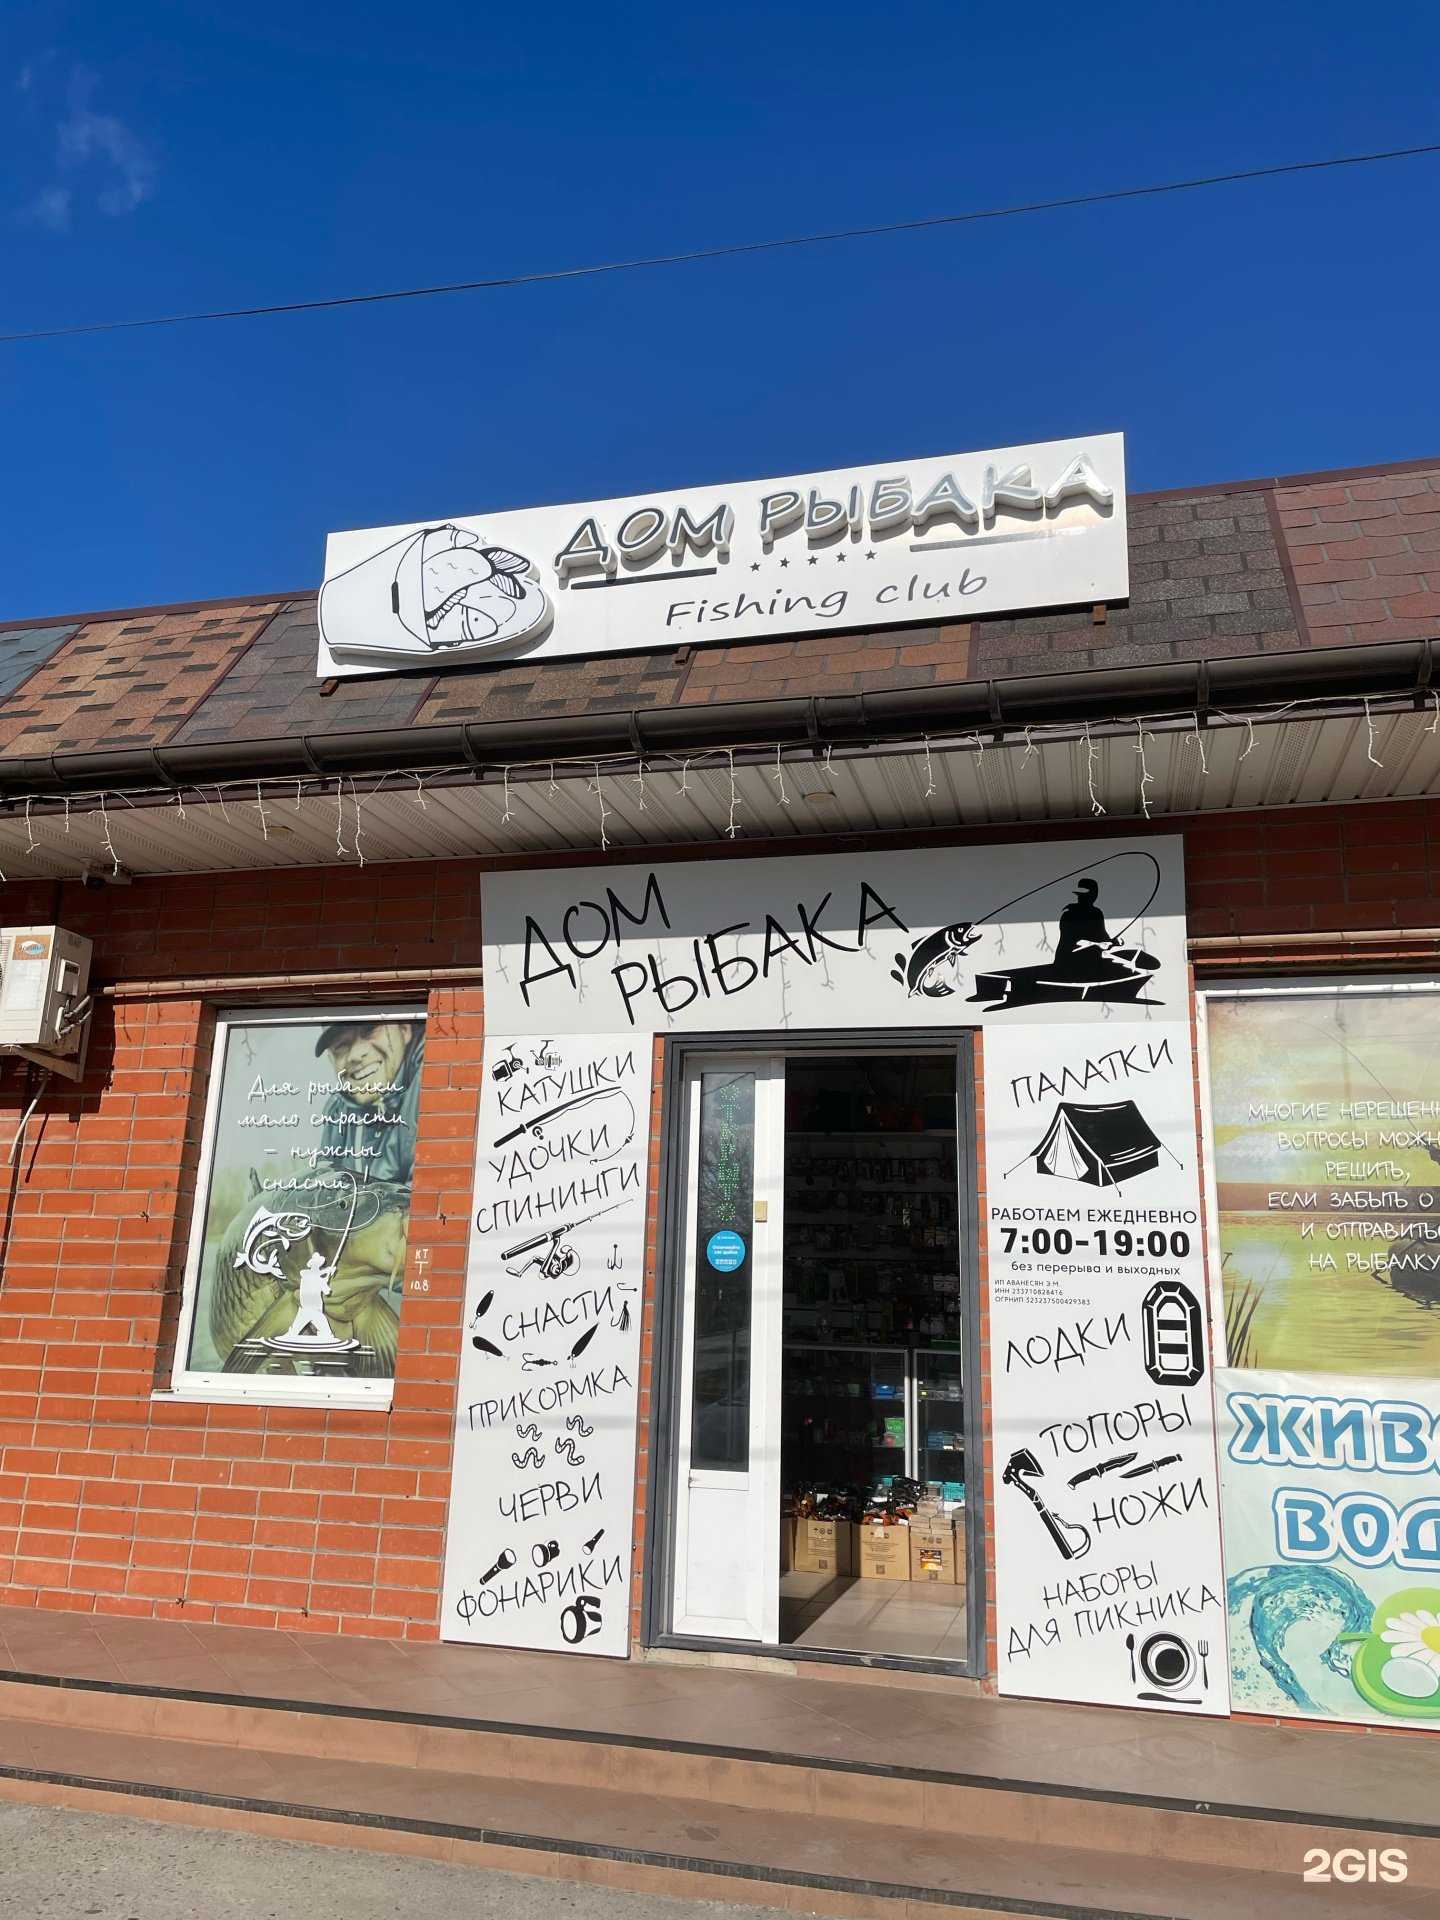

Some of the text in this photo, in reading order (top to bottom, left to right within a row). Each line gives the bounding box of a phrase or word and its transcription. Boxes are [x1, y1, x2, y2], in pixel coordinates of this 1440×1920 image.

[552, 452, 1114, 578] ДОМ РЫБАКА
[665, 569, 988, 627] Fishing club
[519, 873, 671, 1007] ДОМ
[611, 881, 909, 1025] РЫБАКА
[248, 1069, 404, 1102] Для рыбалки
[497, 1051, 635, 1116] КАТУШКИ
[1010, 1038, 1173, 1108] ПАЛАТКИ
[238, 1111, 408, 1134] мало страсти
[1249, 1103, 1331, 1120] МНОГИЕ
[291, 1145, 382, 1168] нужны
[489, 1124, 610, 1188] УДОЧКИ
[1278, 1131, 1368, 1149] ВОПРОСЫ
[477, 1163, 640, 1233] СПИНИНГИ
[1325, 1160, 1411, 1184] РЕШИТЬ,
[991, 1208, 1198, 1225] РАБОТАЕМ ЕЖЕДНЕВНО
[1268, 1191, 1434, 1209] ЕСЛИ ЗАБЫТЬ О
[1000, 1227, 1191, 1258] 7:00-19:00
[1302, 1222, 1440, 1241] И ОТПРАВИТЬ
[1011, 1261, 1033, 1272] без
[1036, 1264, 1101, 1275] перерыва
[1117, 1266, 1181, 1276] выходных
[1310, 1253, 1440, 1271] НА РЫБАЛКУ
[503, 1286, 614, 1341] СНАСТИ
[1006, 1313, 1131, 1373] ЛОДКИ
[468, 1365, 632, 1431] ПРИКОРМКА
[1039, 1393, 1192, 1457] ТОПОРЫ
[1227, 1392, 1440, 1475] ЖИВ
[499, 1472, 602, 1522] ЧЕРВИ
[1092, 1477, 1208, 1533] НОЖИ
[456, 1555, 623, 1626] ФОНАРИКИ
[1043, 1560, 1158, 1610] НАБОРЫ
[1007, 1585, 1222, 1663] ДЛЯ ПИКНИКА
